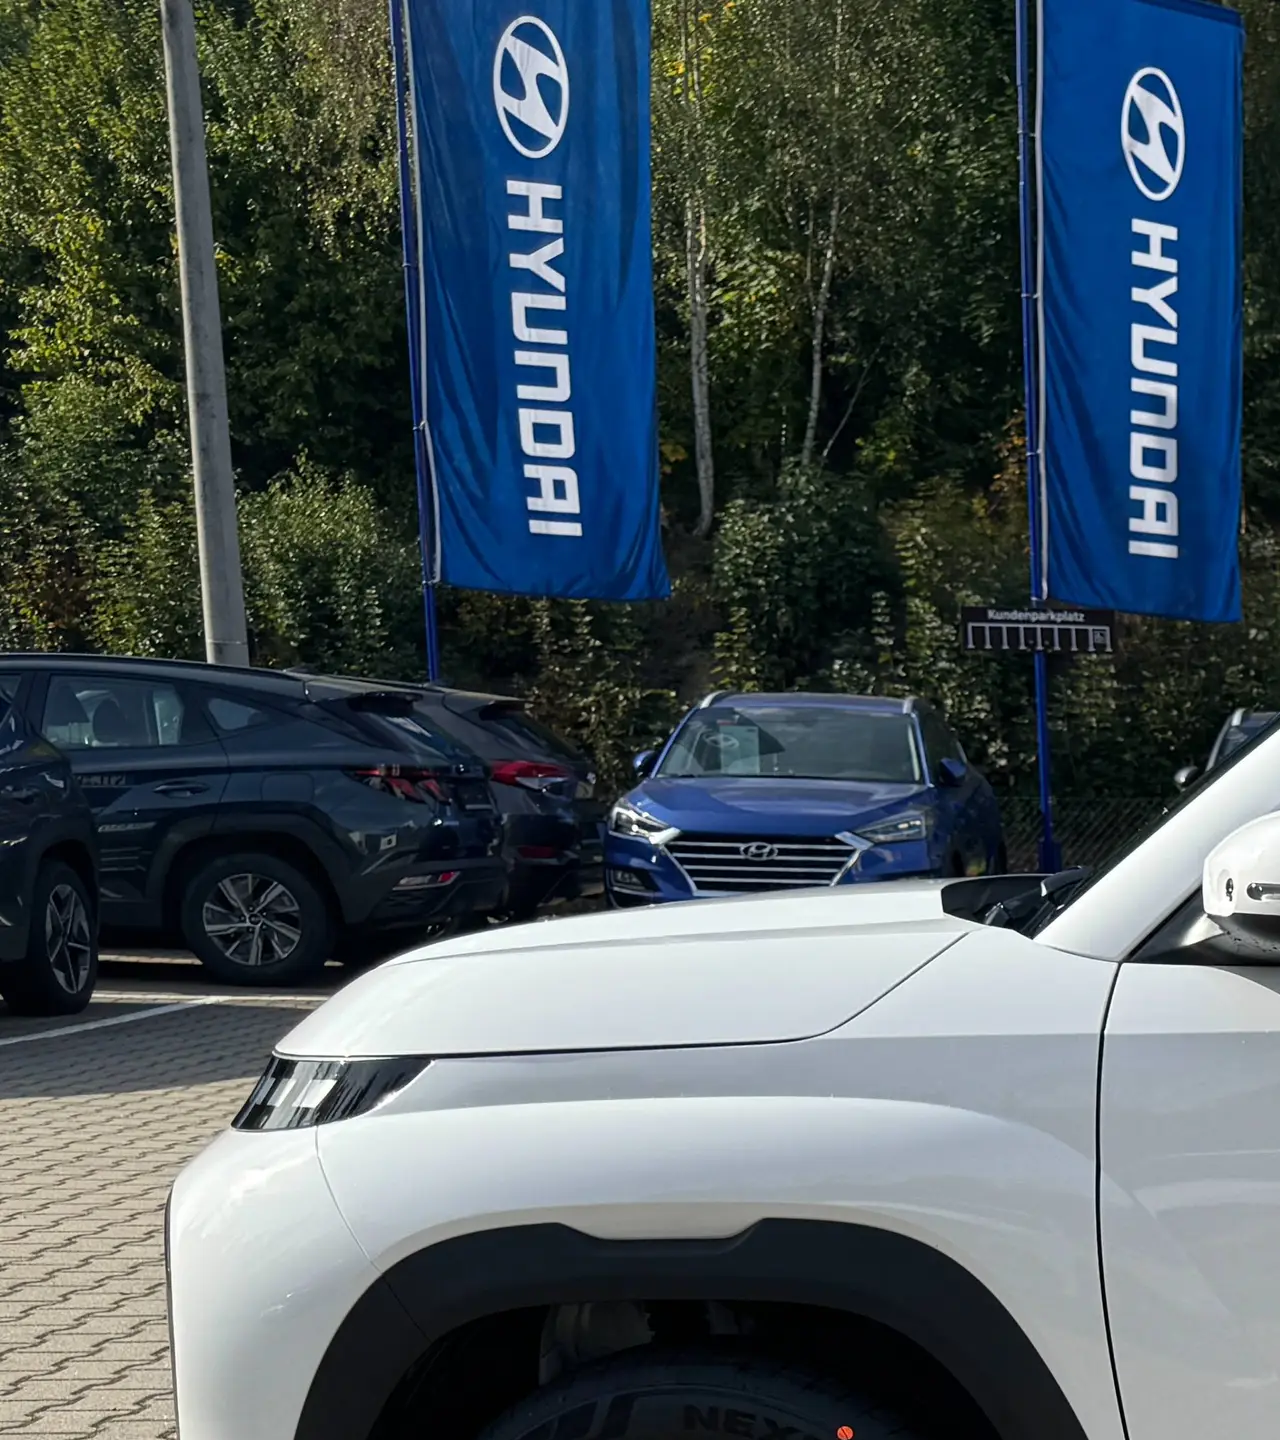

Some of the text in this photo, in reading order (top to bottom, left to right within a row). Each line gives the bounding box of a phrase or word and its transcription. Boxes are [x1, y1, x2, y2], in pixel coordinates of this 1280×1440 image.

[506, 179, 583, 537] HYUNDAI
[1129, 218, 1178, 559] HYUNDAI
[987, 608, 1085, 623] Kundenparkplatz
